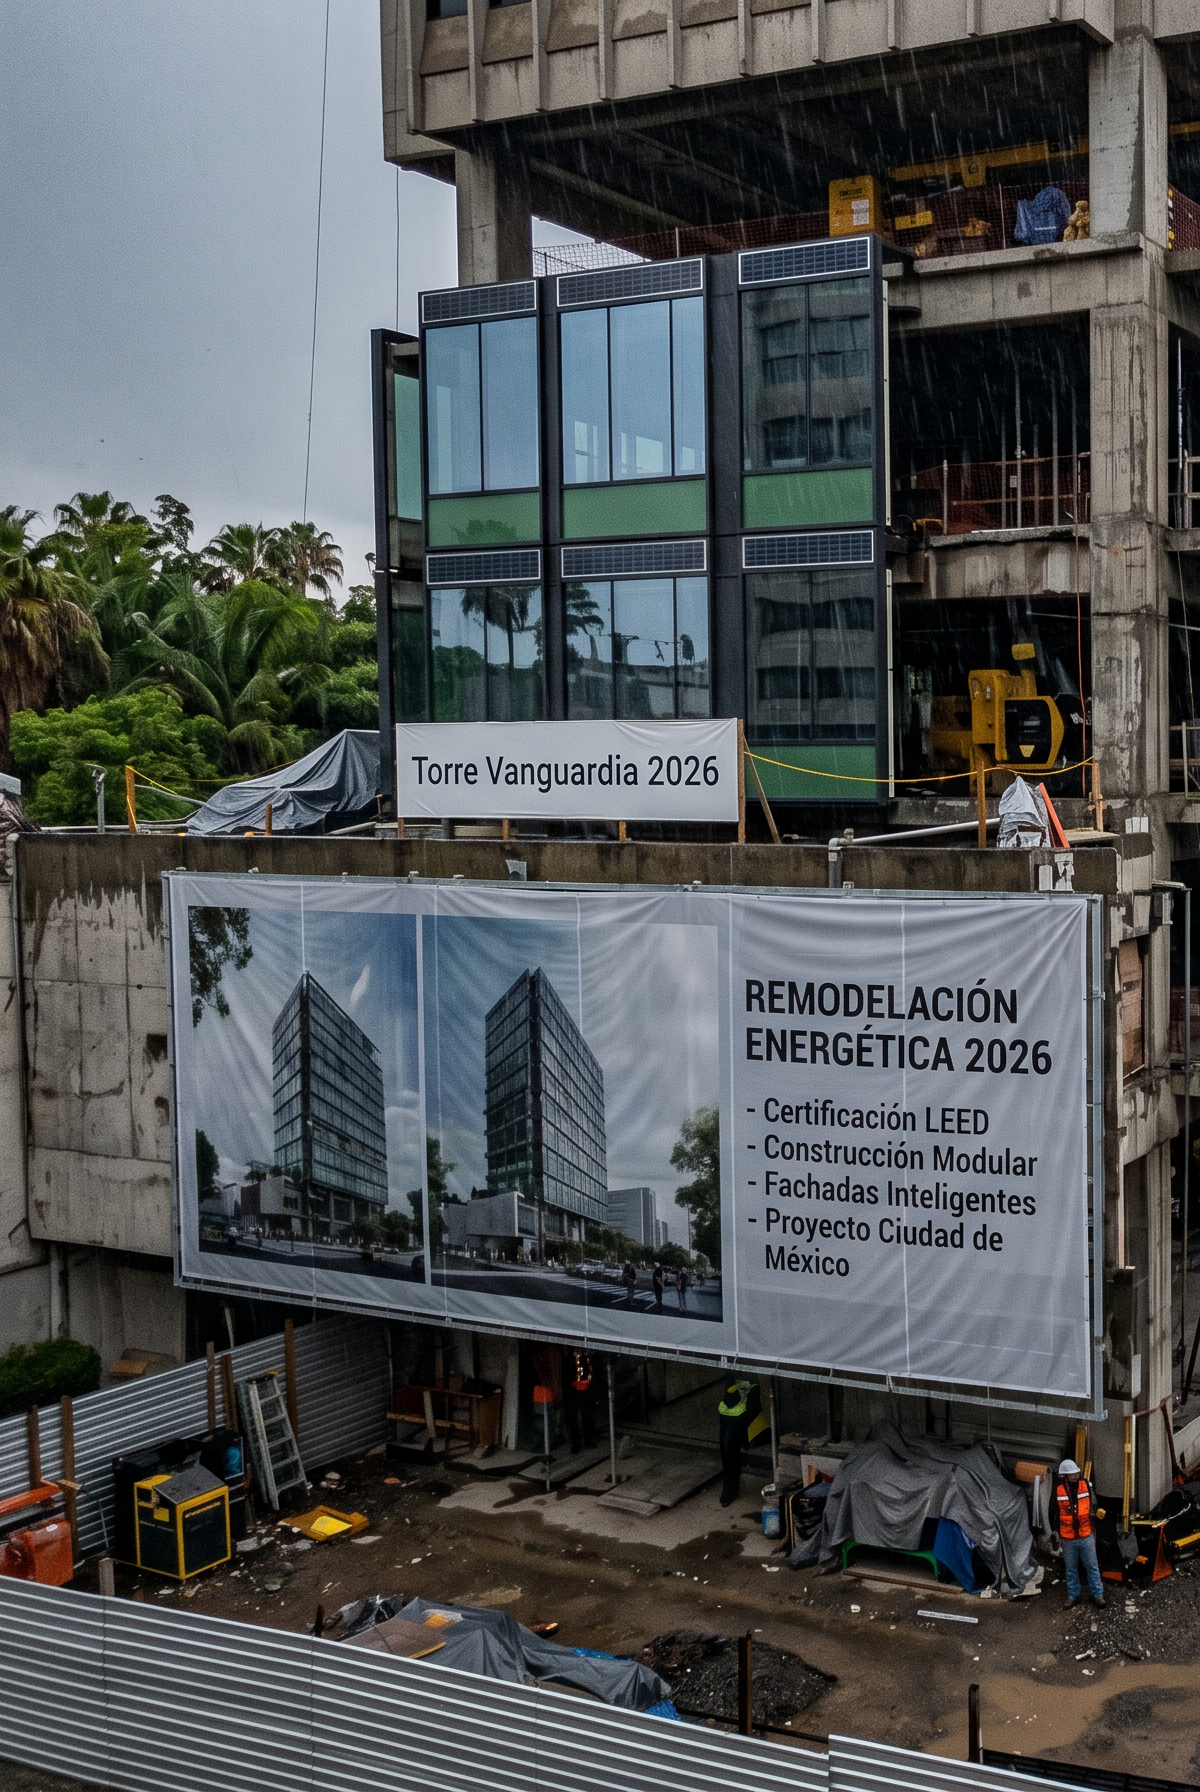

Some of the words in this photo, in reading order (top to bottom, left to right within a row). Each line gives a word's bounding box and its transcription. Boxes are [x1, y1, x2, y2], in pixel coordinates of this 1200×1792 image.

[410, 755, 478, 786] Torre
[485, 754, 639, 794] Vanguardia
[647, 755, 720, 787] 2026
[745, 978, 1019, 1024] REMODELACIÓN
[745, 1024, 955, 1072] ENERGÉTICA
[964, 1037, 1053, 1076] 2026
[763, 1097, 917, 1132] Certificación
[925, 1106, 990, 1136] LEED
[764, 1134, 925, 1171] Construcción
[933, 1145, 1039, 1177] Modular
[764, 1170, 880, 1206] Fachadas
[886, 1180, 1037, 1218] Inteligentes
[765, 1207, 872, 1244] Proyecto
[878, 1217, 965, 1251] Ciudad
[972, 1223, 1004, 1253] de
[764, 1244, 851, 1278] México
